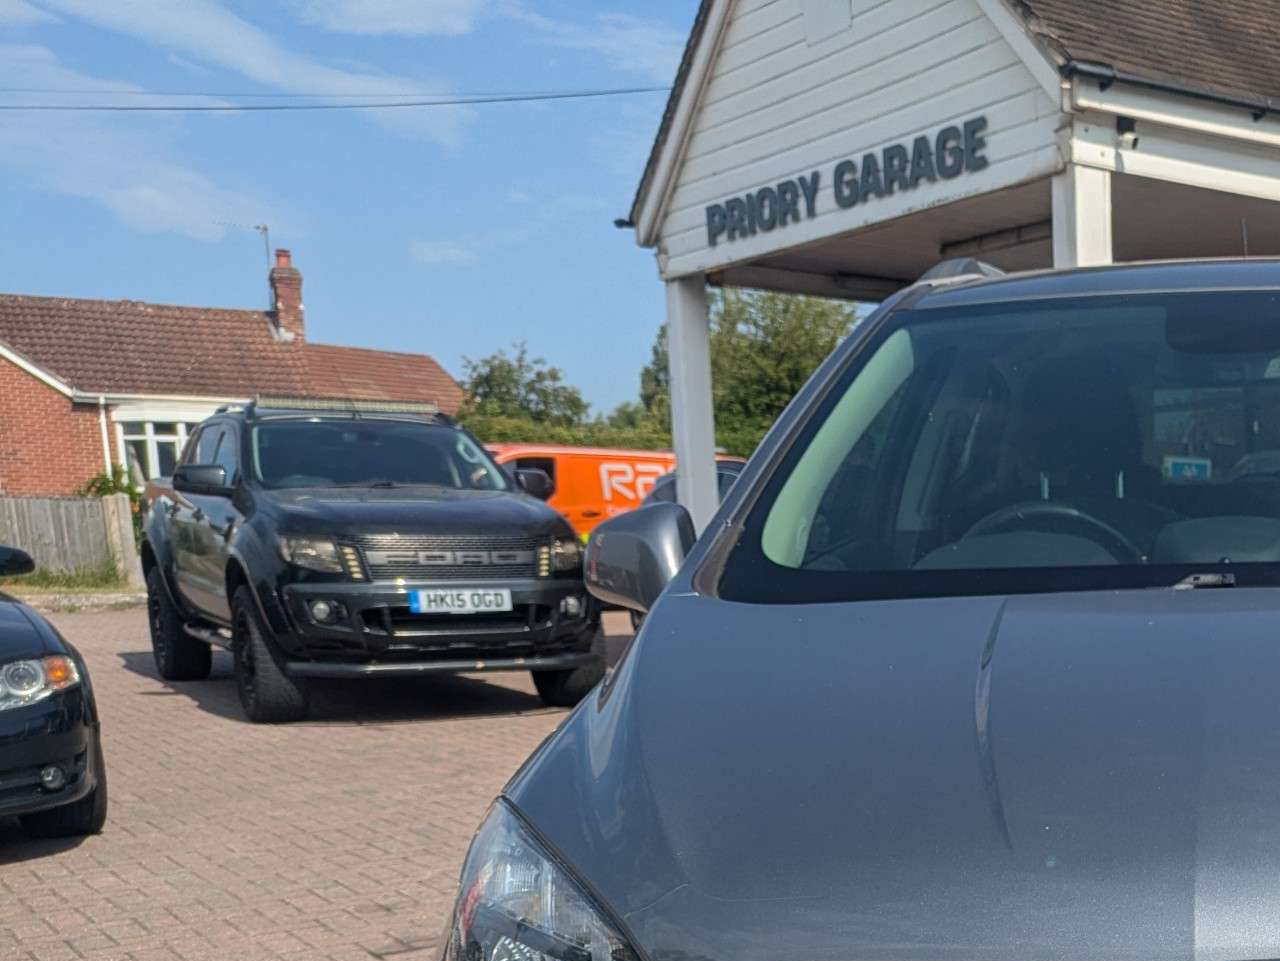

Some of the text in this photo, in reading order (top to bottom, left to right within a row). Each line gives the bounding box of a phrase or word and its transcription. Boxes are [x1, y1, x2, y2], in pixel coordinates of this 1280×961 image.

[706, 115, 989, 247] PRIORY GARAGE
[427, 592, 466, 609] HK15
